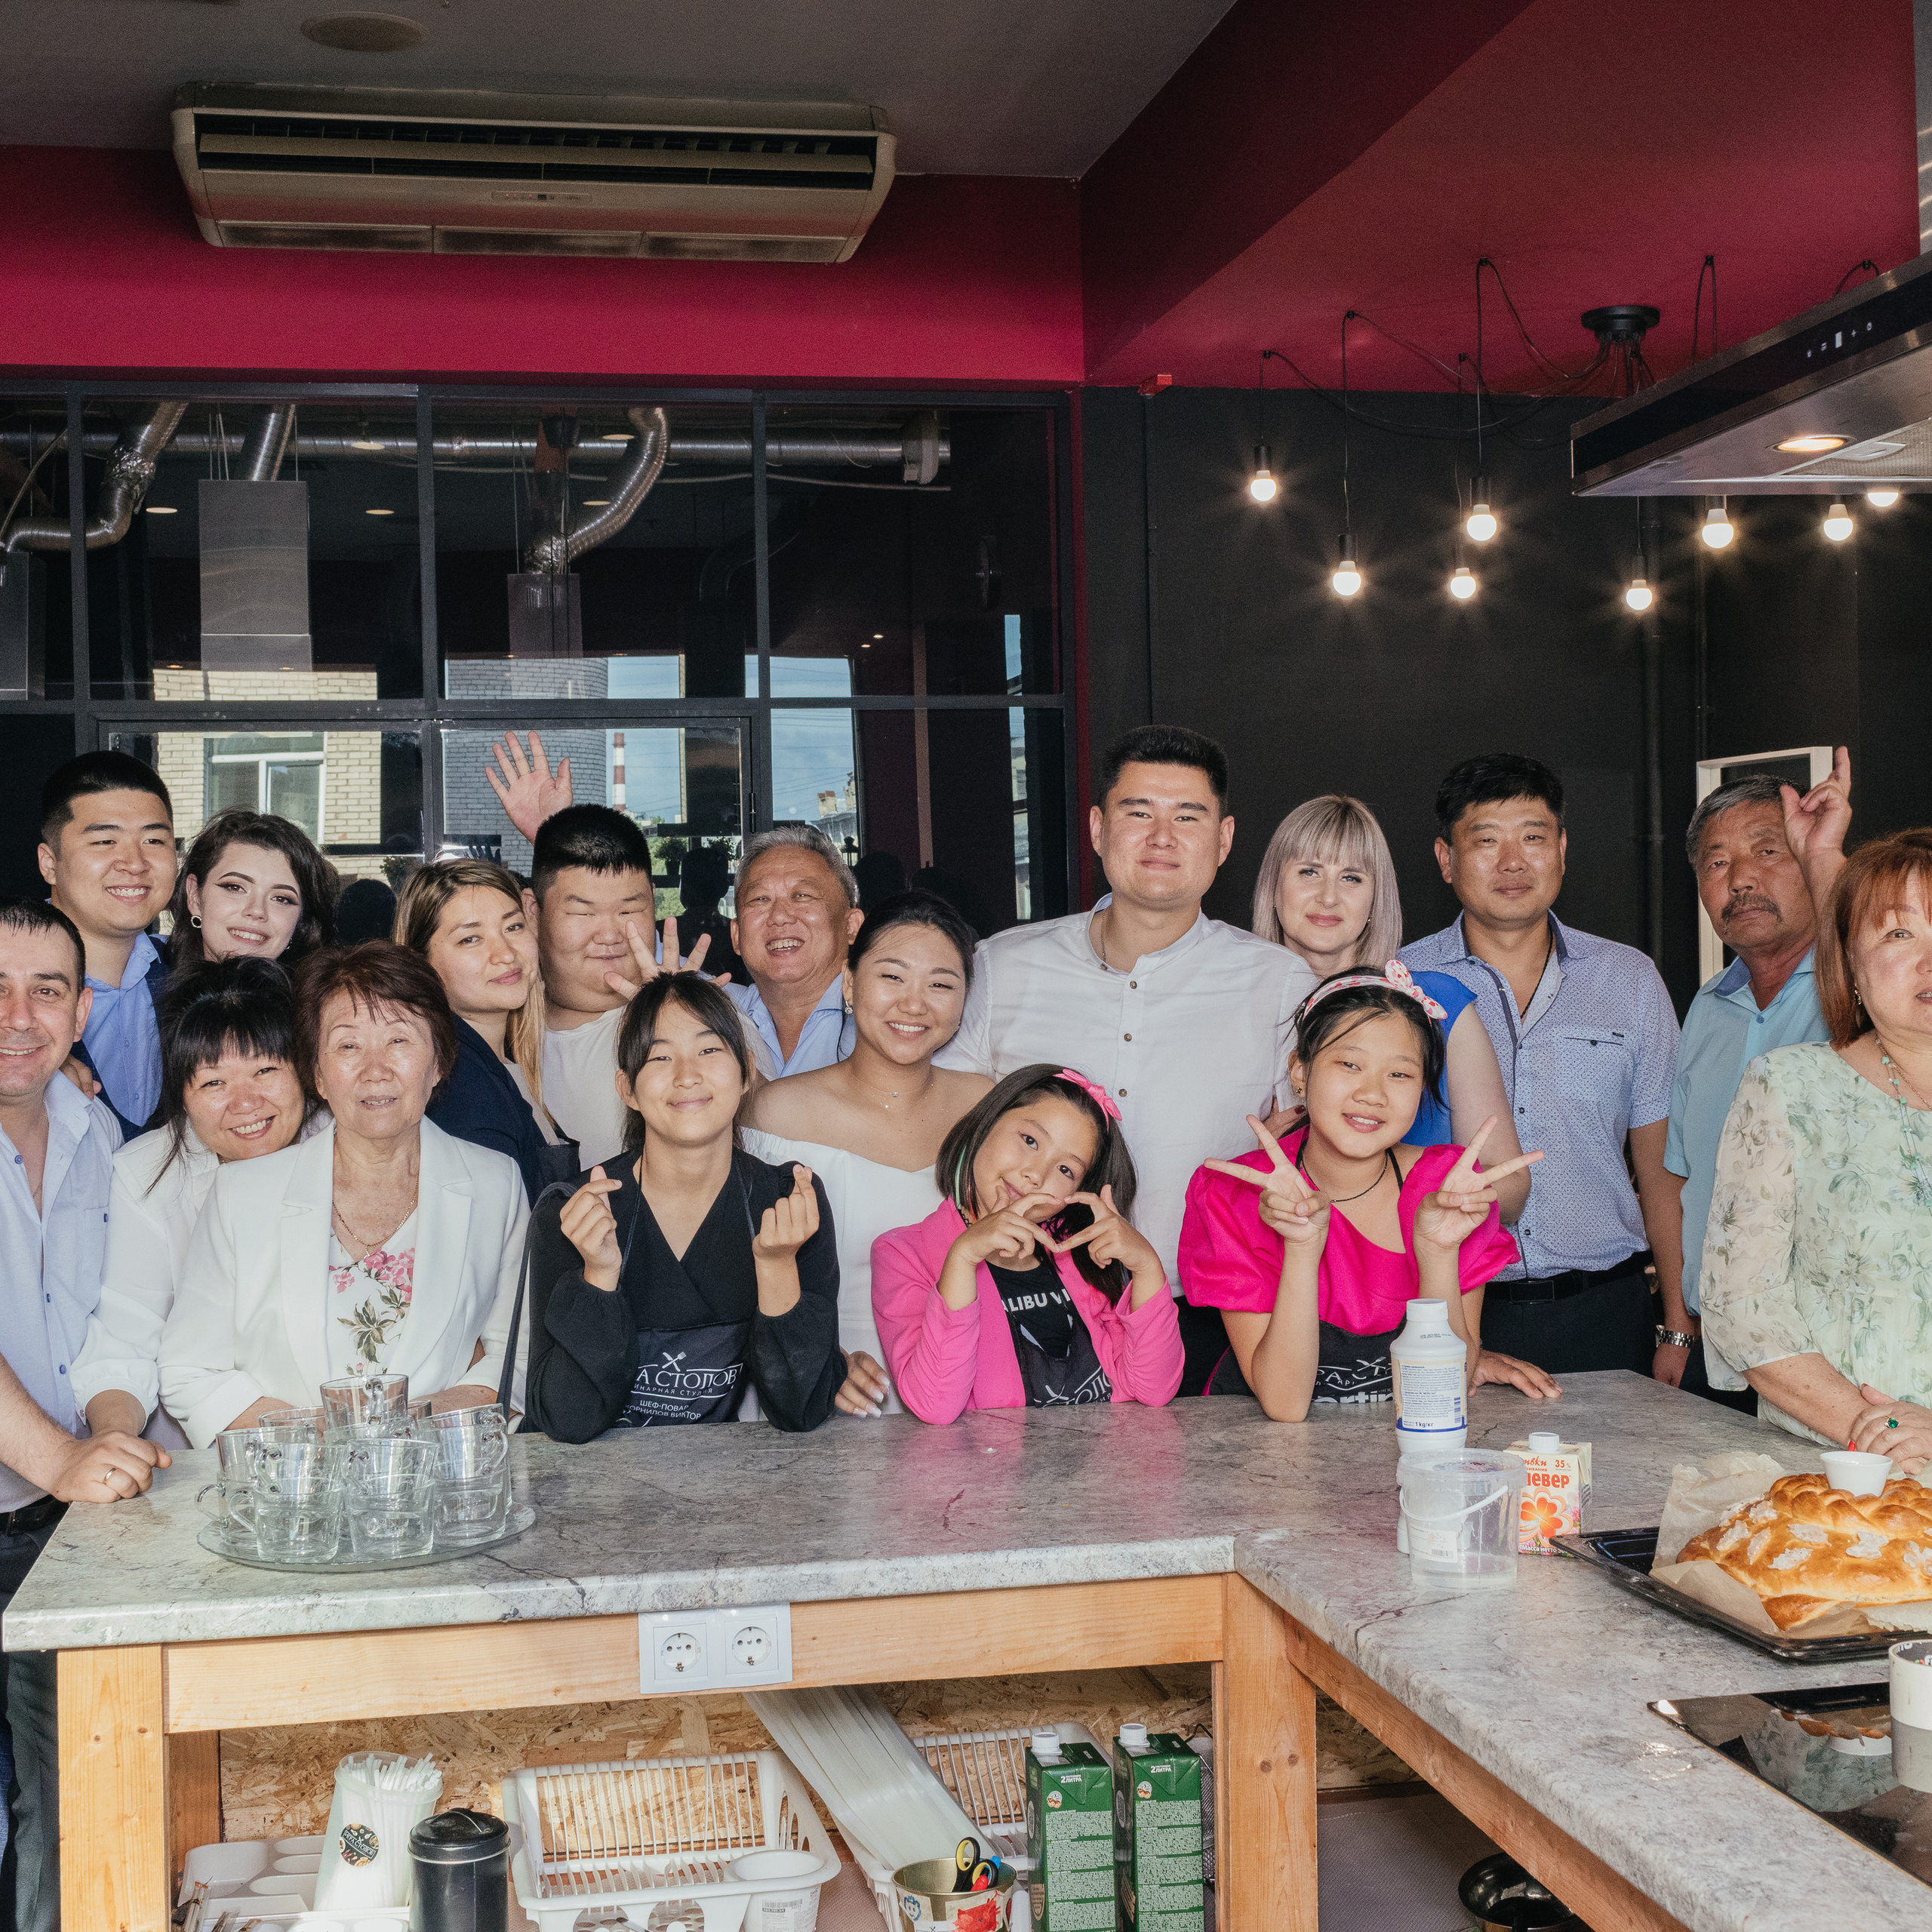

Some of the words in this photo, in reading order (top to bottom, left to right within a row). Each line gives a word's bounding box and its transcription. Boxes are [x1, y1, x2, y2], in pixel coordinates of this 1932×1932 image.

[655, 1368, 737, 1389] СТОЛОВ
[640, 1399, 689, 1411] ШЕФ-ПОВАР
[670, 1411, 701, 1420] ВИКТОР
[1524, 1455, 1547, 1466] ивки
